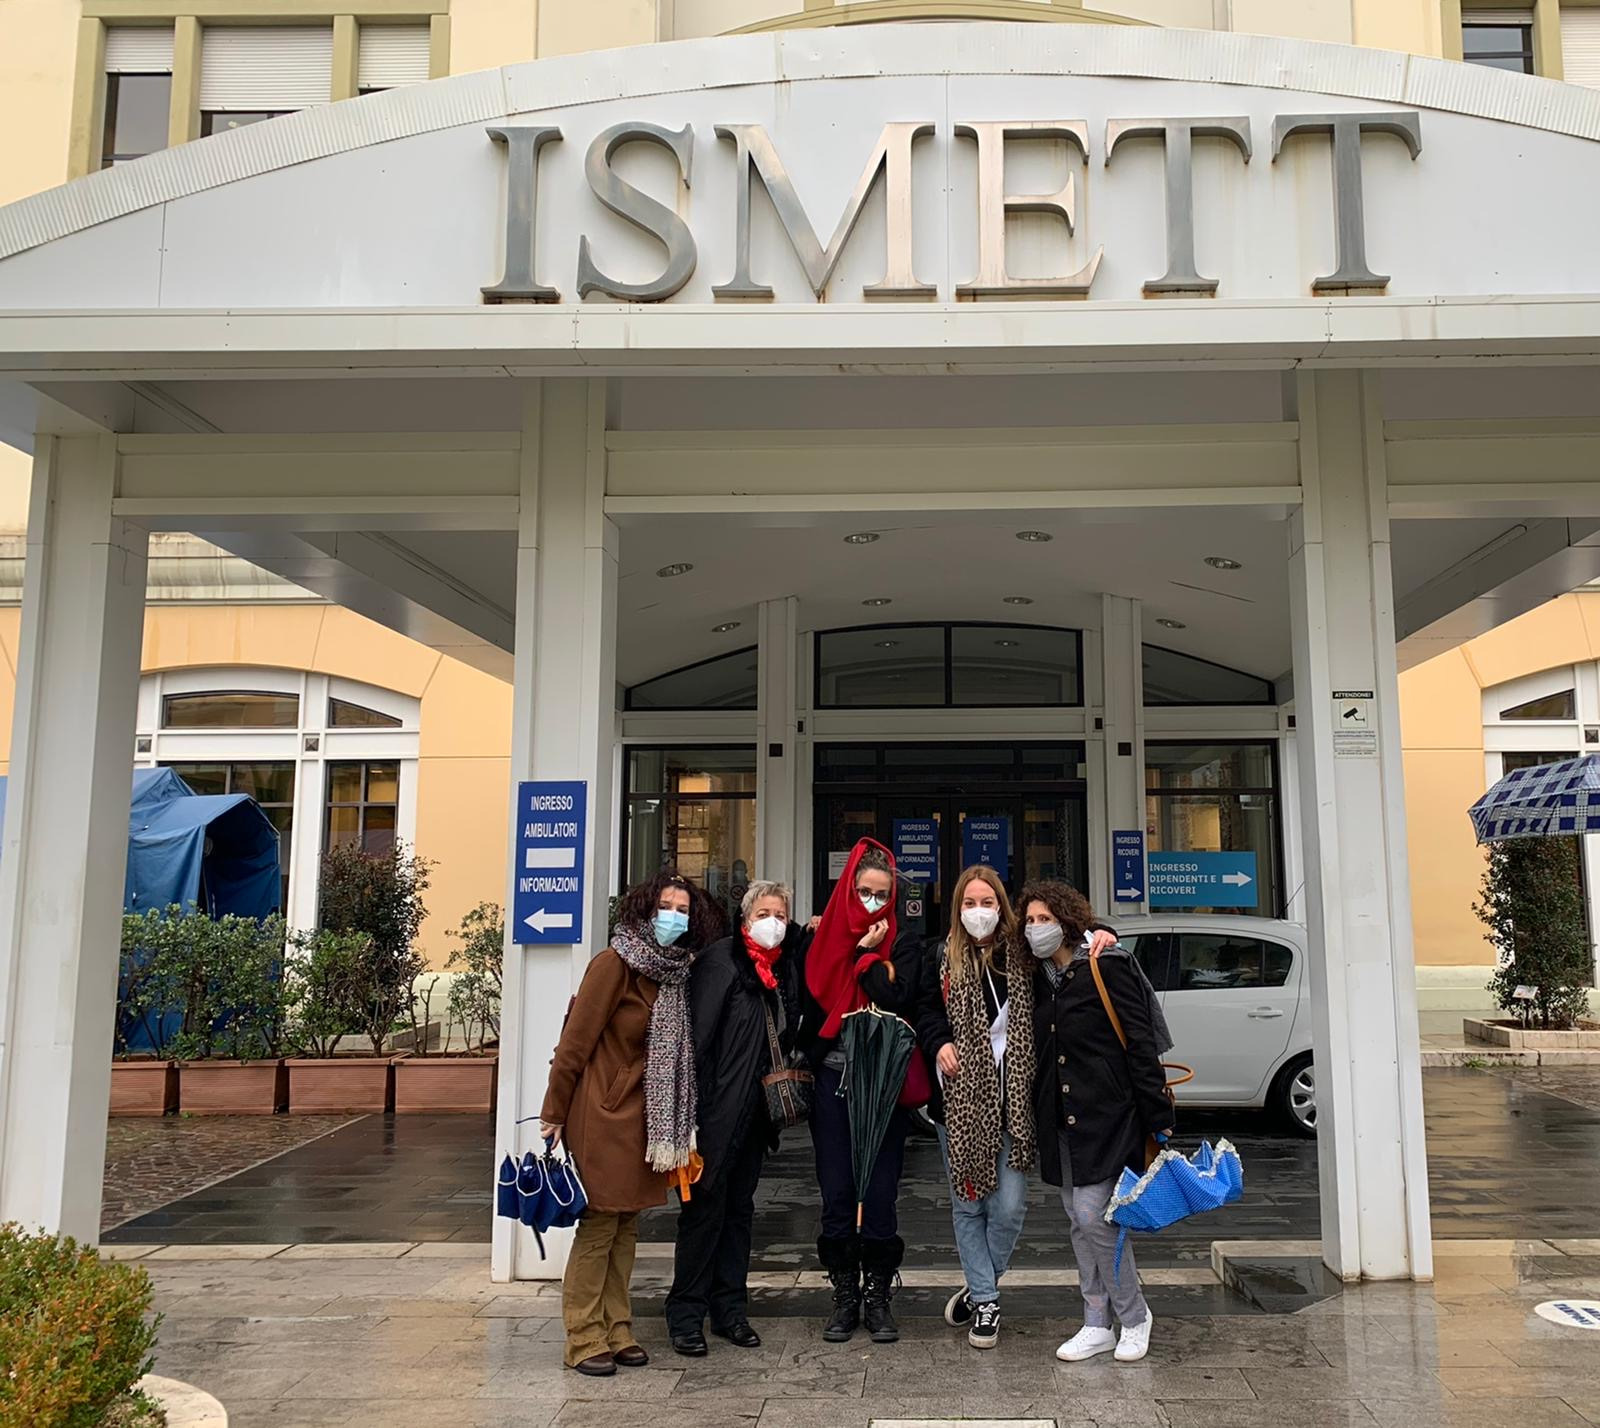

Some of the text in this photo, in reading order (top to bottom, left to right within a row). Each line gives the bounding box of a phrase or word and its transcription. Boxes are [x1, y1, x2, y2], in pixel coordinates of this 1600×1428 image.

[480, 111, 1422, 303] ISMETT
[531, 796, 573, 811] INGRESSO
[524, 823, 577, 838] AMBULATORI
[1116, 836, 1140, 844] INGRESSO
[1117, 848, 1139, 856] RICOVERI
[1126, 860, 1131, 868] E
[1149, 863, 1198, 871] INGRESSO
[1150, 874, 1217, 883] DIPENDENTI E
[520, 877, 578, 892] INFORMAZIONI
[1150, 886, 1196, 895] RICOVERI
